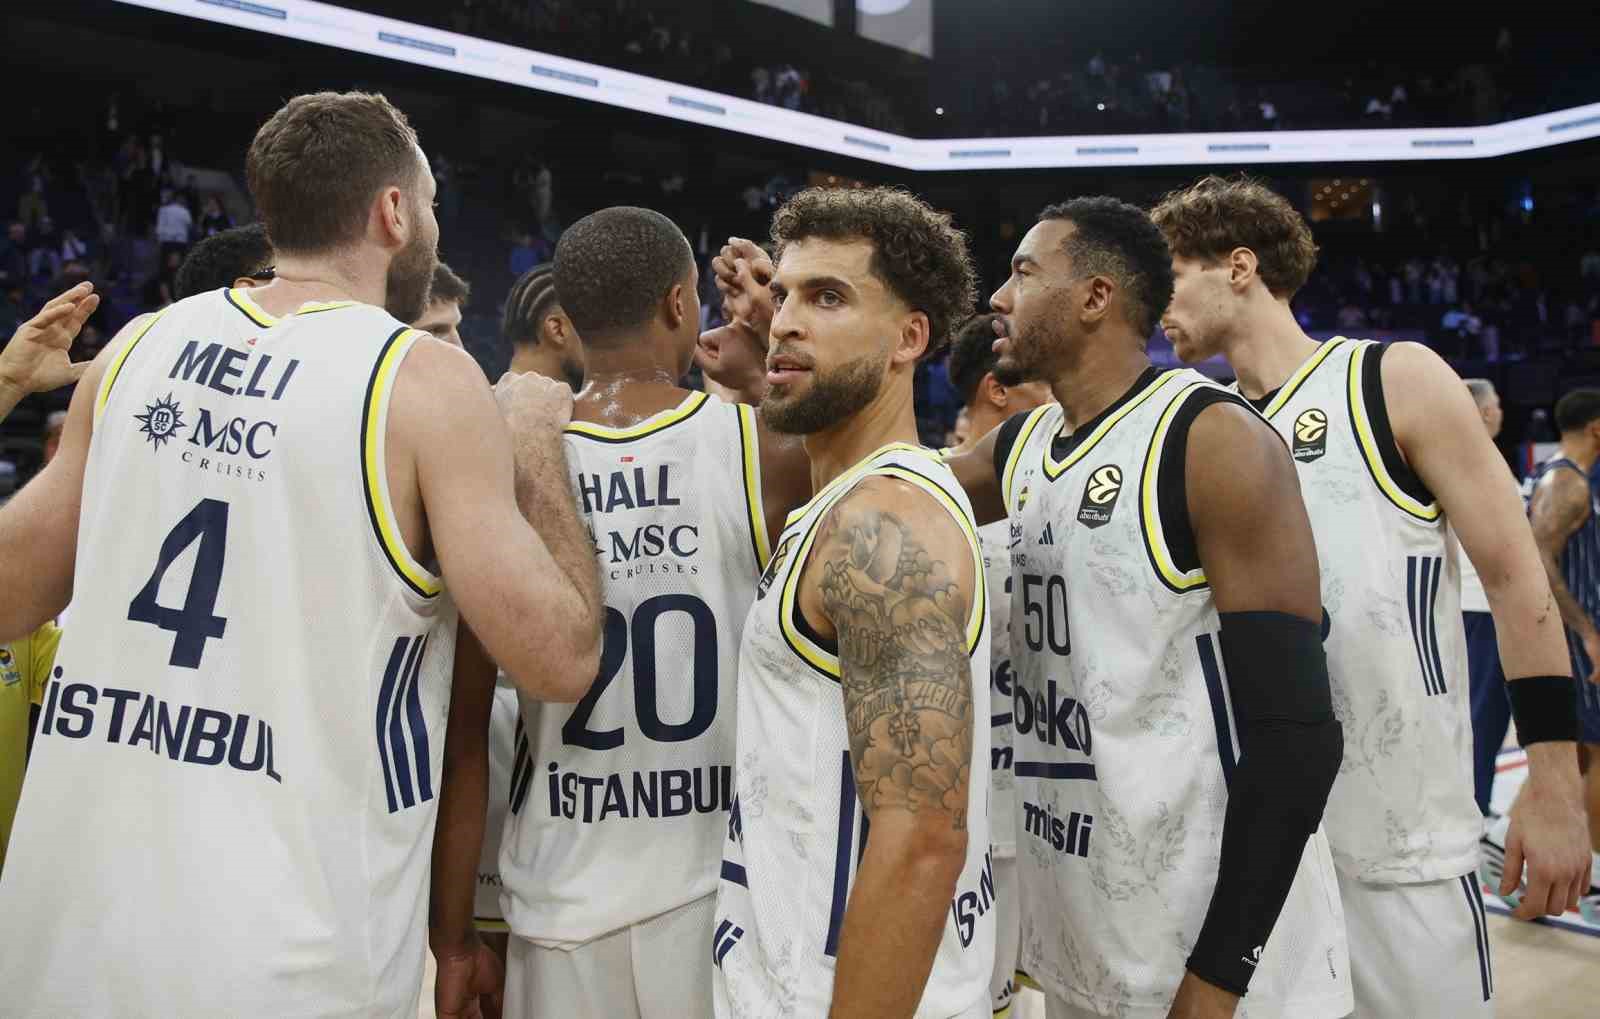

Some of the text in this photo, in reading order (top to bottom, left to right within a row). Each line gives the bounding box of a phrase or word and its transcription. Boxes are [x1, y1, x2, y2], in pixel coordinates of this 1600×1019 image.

[187, 408, 277, 459] MSC
[578, 464, 681, 513] HALL
[608, 525, 698, 563] MSC
[610, 563, 698, 580] CRUISES
[128, 498, 230, 669] 4
[1023, 574, 1071, 656] 50
[562, 593, 718, 751] 20
[1012, 670, 1092, 757] beko
[1023, 802, 1093, 858] misli
